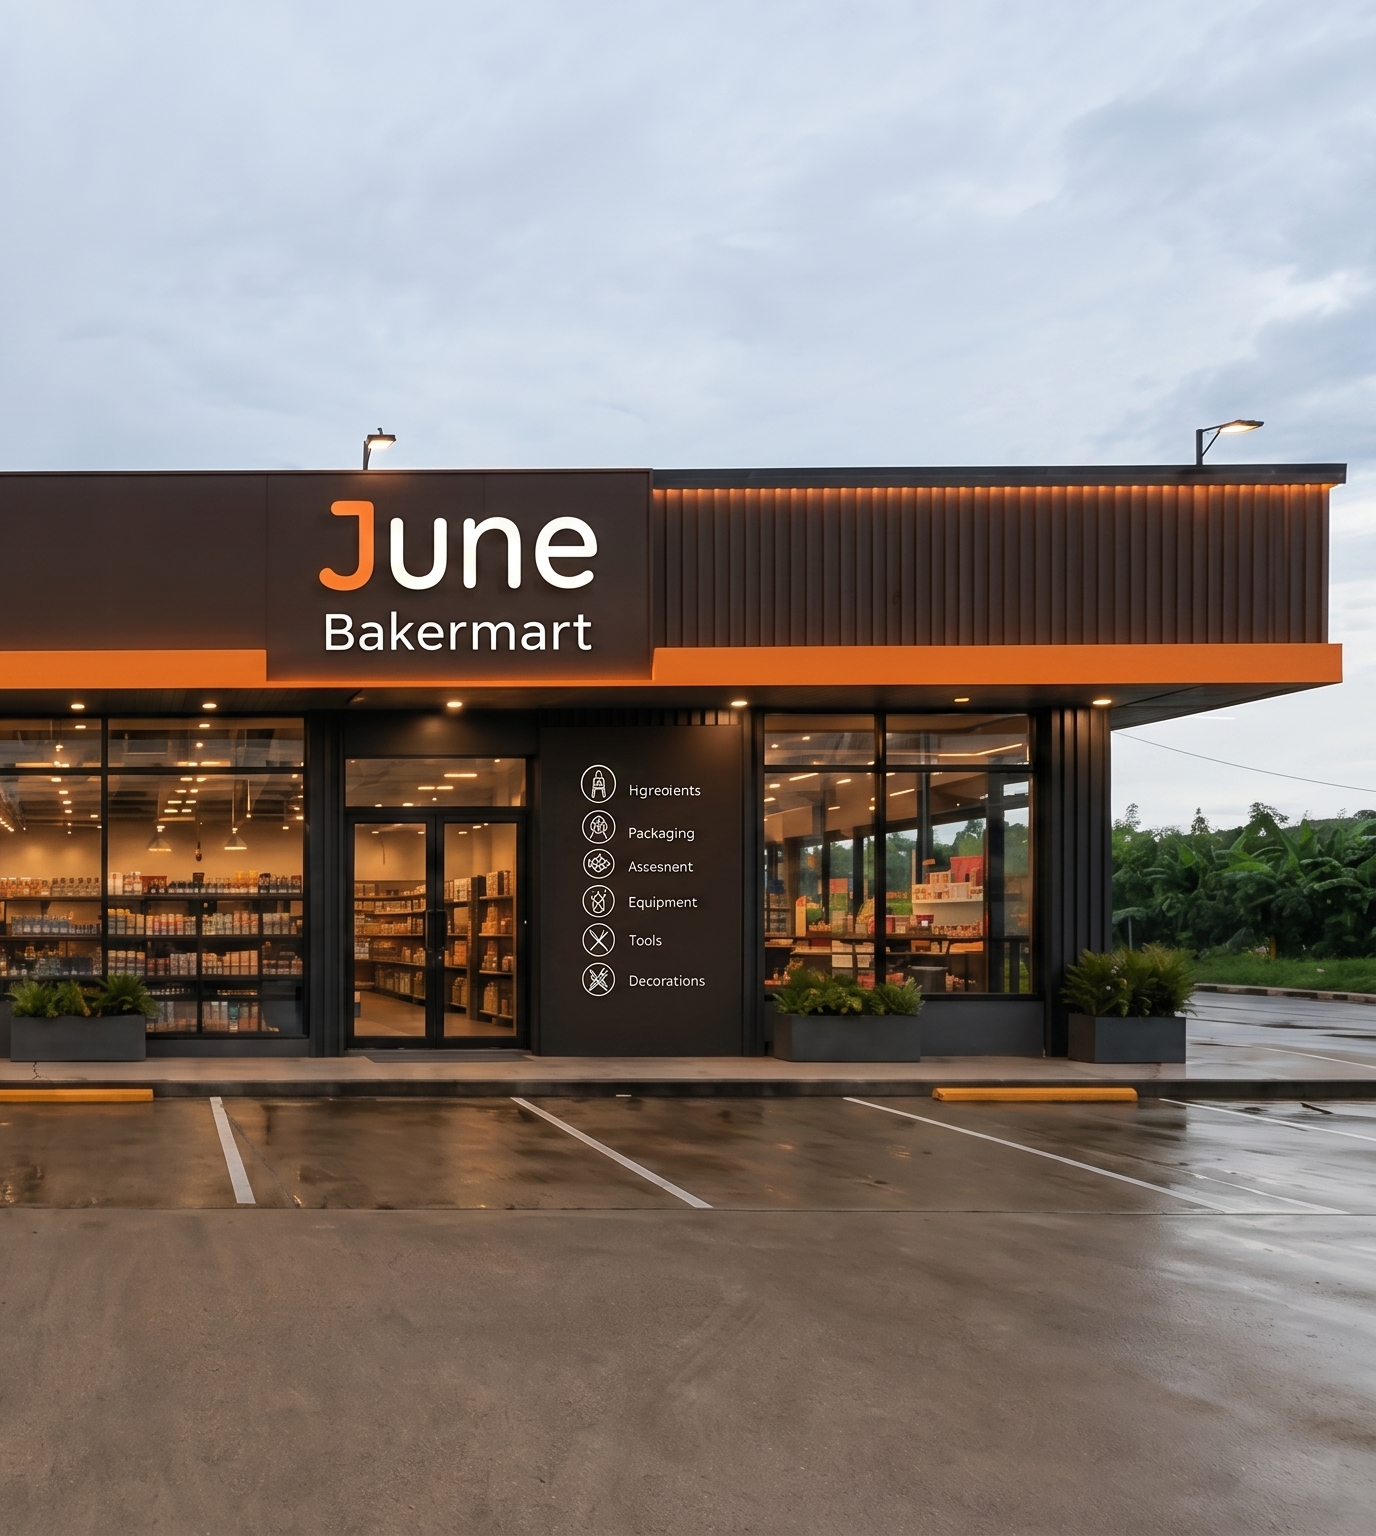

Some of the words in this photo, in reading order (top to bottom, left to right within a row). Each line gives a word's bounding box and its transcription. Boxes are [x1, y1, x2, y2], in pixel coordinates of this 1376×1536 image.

[319, 500, 598, 591] June
[325, 610, 592, 651] Bakermart
[628, 827, 695, 842] Packaging
[628, 895, 698, 911] Equipment
[628, 934, 663, 947] Tools
[629, 974, 706, 987] Decorations
